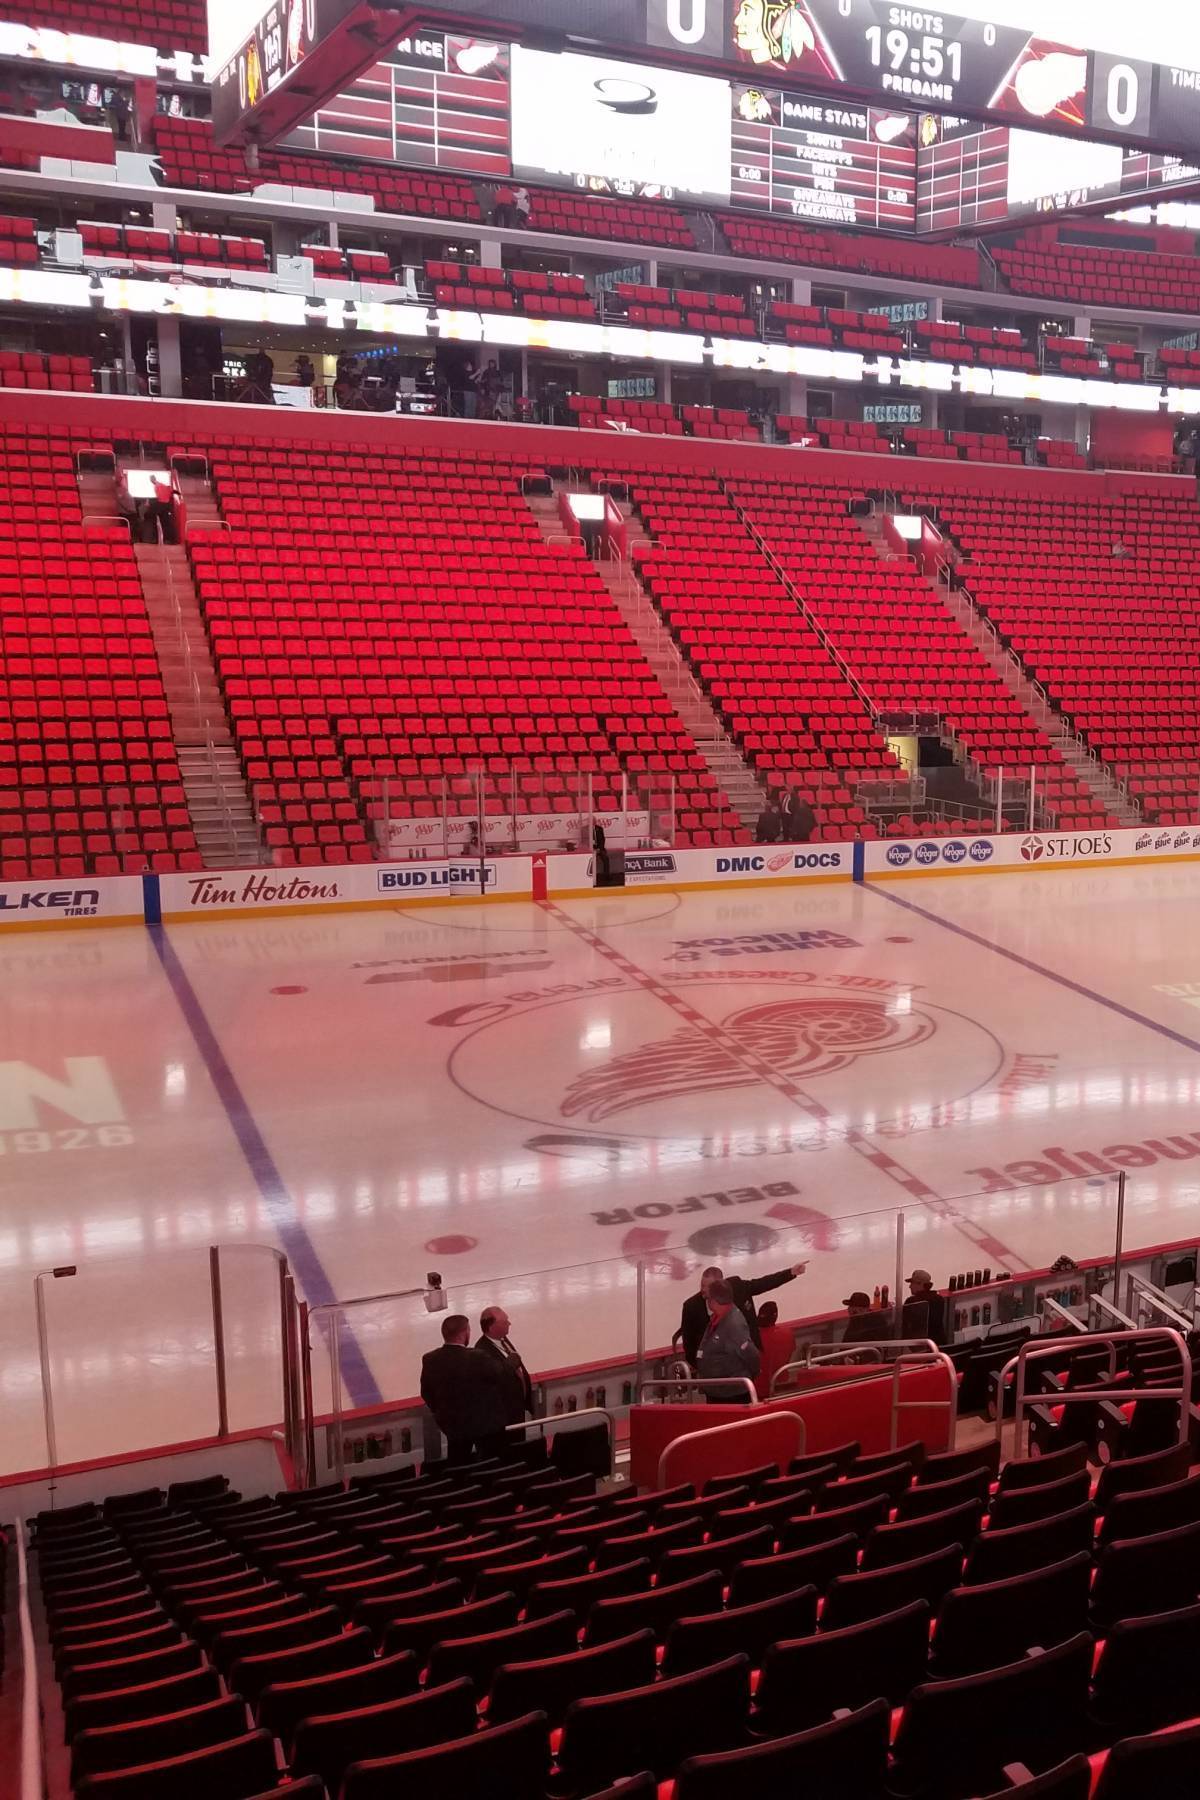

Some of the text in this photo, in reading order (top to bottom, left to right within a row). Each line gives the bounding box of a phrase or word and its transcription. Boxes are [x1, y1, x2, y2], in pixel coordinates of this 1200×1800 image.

[667, 0, 706, 44] 0
[889, 8, 944, 34] SHOTS
[983, 24, 996, 46] 0
[416, 40, 444, 58] ICE
[865, 26, 962, 82] 19:51
[882, 73, 953, 101] PREGAME
[1107, 64, 1139, 126] 0
[784, 102, 866, 129] GAME STATS
[888, 848, 911, 864] Kroger
[916, 846, 938, 862] Kroger
[943, 845, 966, 861] Kroger
[971, 843, 992, 860] Kroger
[1046, 833, 1112, 858] ST. JOE'S
[644, 857, 669, 869] Bank
[716, 852, 841, 873] DMC DOCS
[382, 869, 491, 888] BUD LIGHT
[188, 874, 338, 905] Tim Hortons
[64, 907, 97, 916] TIRES
[663, 938, 864, 962] Burns &
[671, 930, 848, 949] Wilcox
[660, 970, 817, 983] Caesars
[593, 1180, 801, 1226] BELFOR
